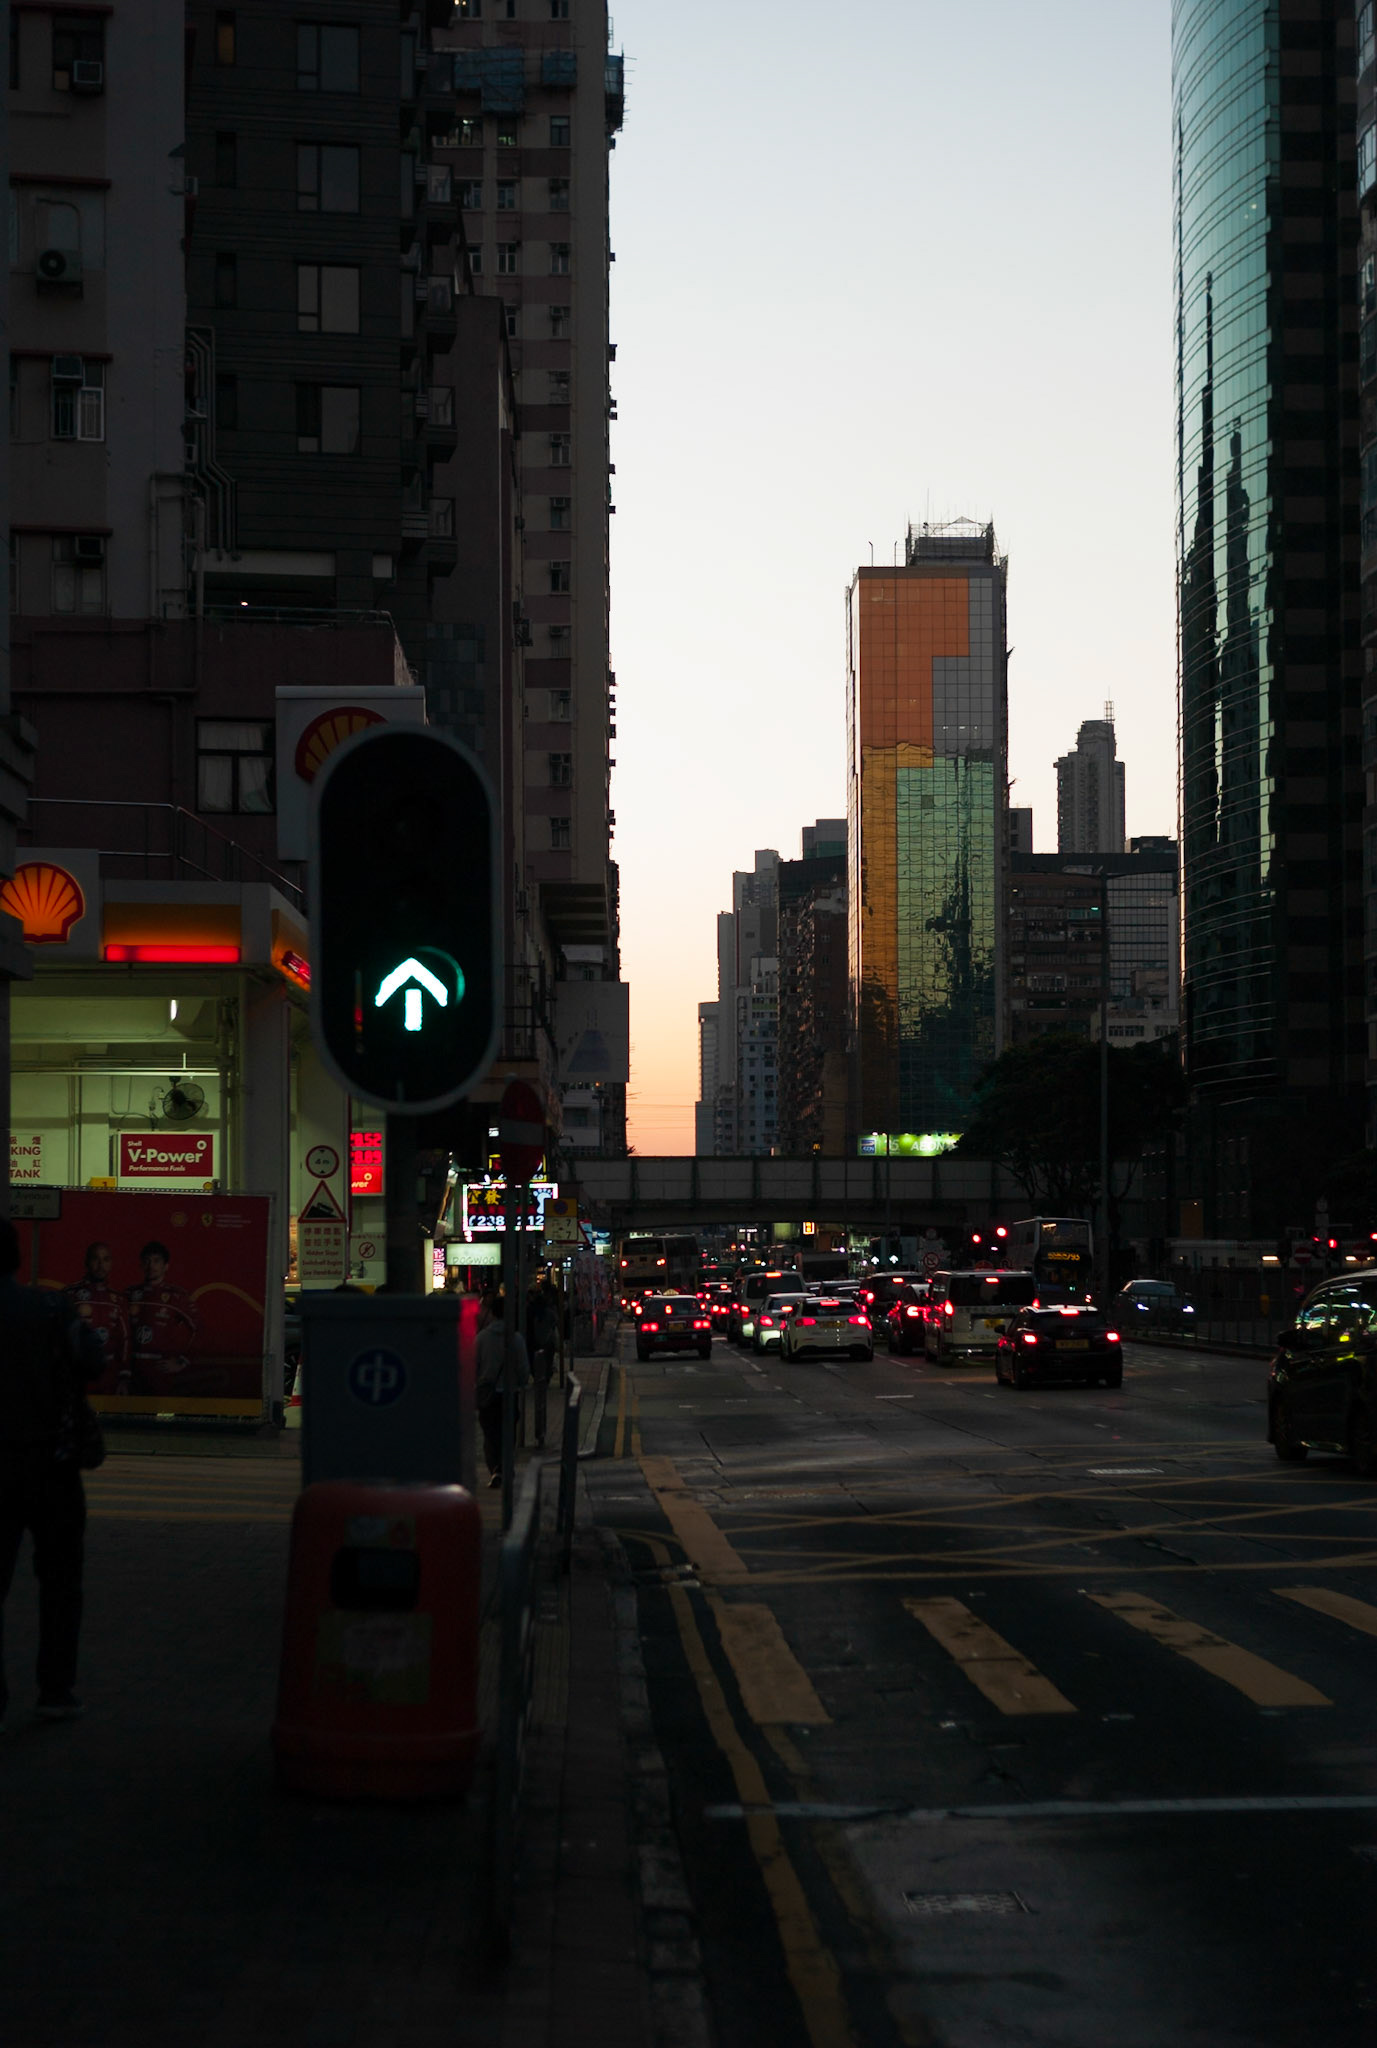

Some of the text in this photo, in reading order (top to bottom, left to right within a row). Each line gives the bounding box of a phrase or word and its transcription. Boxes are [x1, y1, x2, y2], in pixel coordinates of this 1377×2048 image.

[10, 1146, 41, 1155] KING
[127, 1148, 203, 1163] V-Power
[128, 1164, 186, 1172] Performance Fuels
[8, 1169, 41, 1178] TANK
